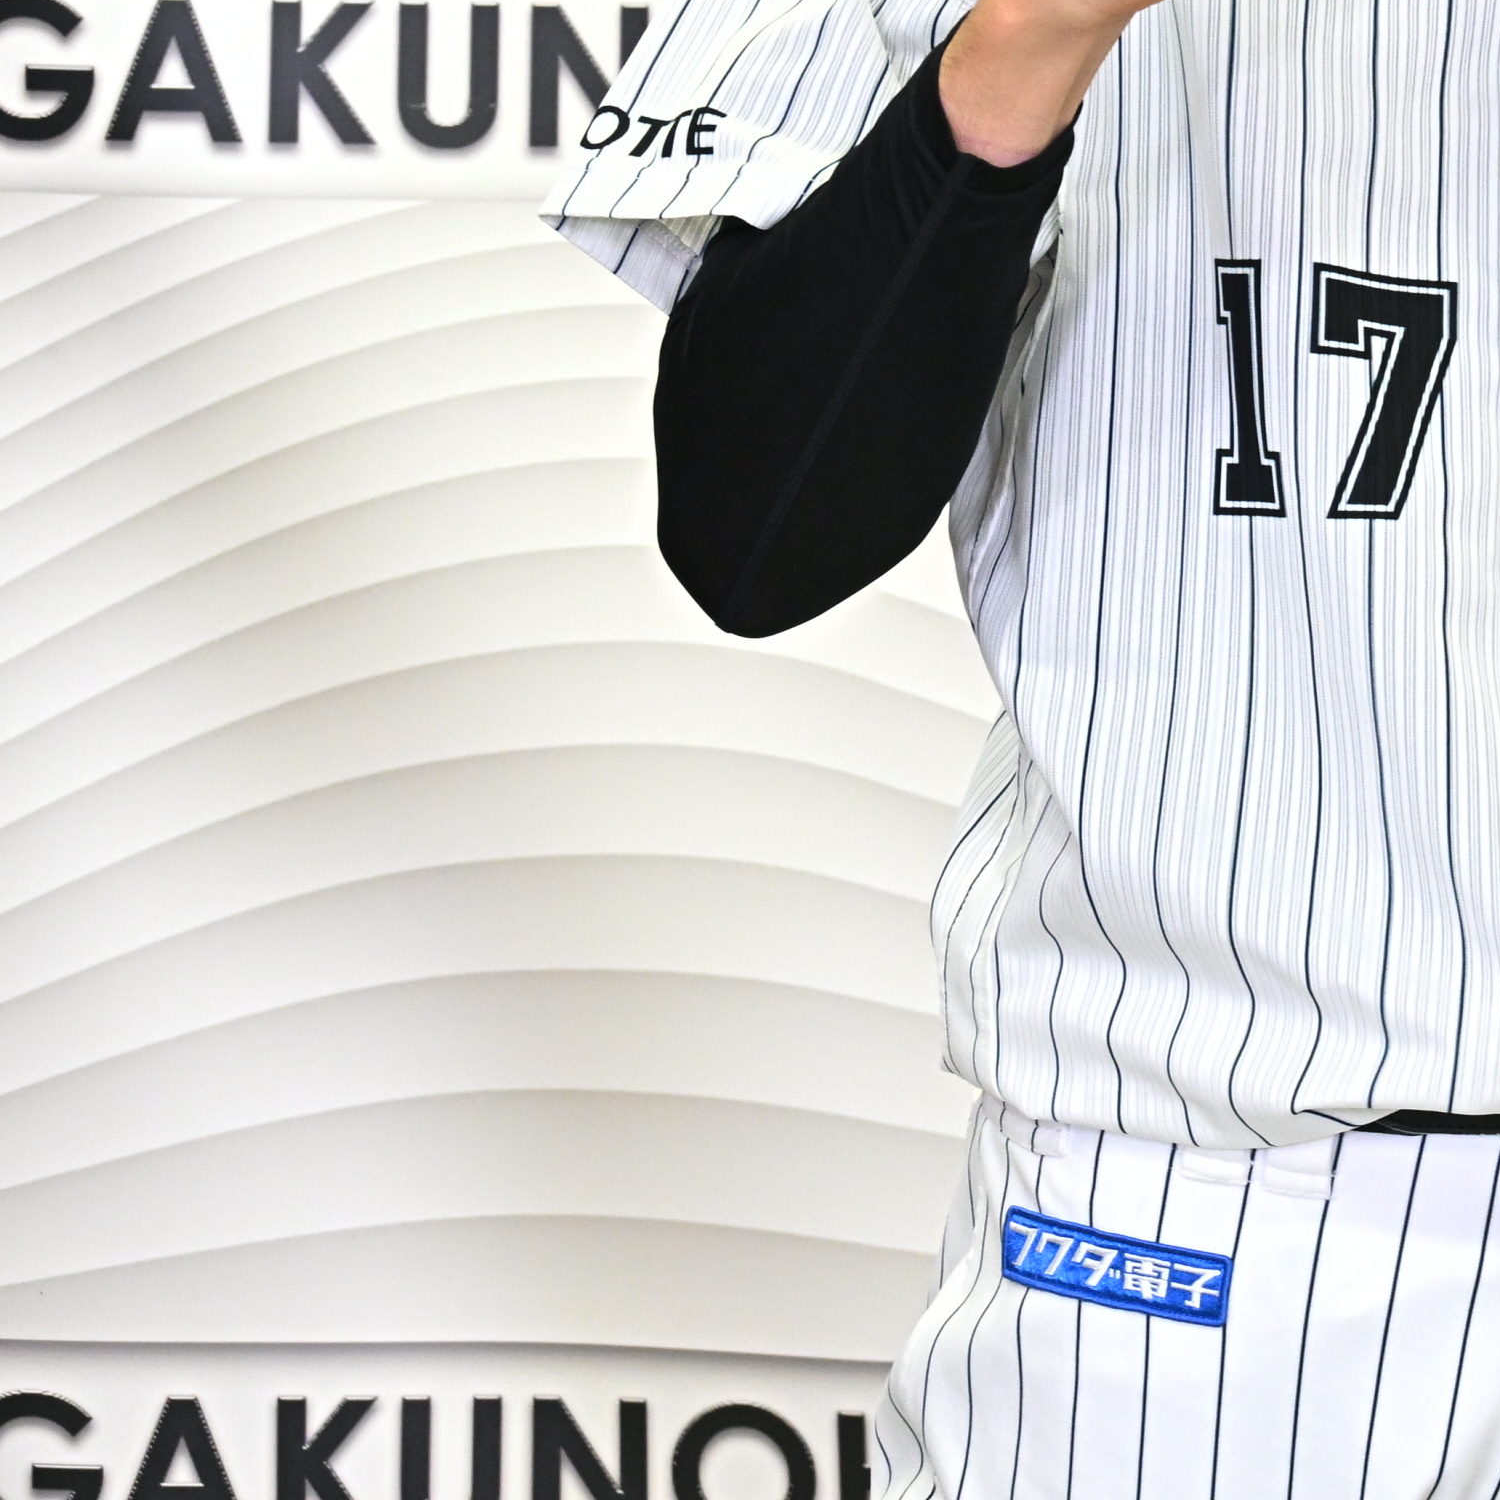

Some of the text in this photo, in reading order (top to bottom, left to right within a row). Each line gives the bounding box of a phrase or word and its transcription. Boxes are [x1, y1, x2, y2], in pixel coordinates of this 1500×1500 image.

[1213, 258, 1458, 520] 17
[1009, 1221, 1221, 1309] フクダ電子
